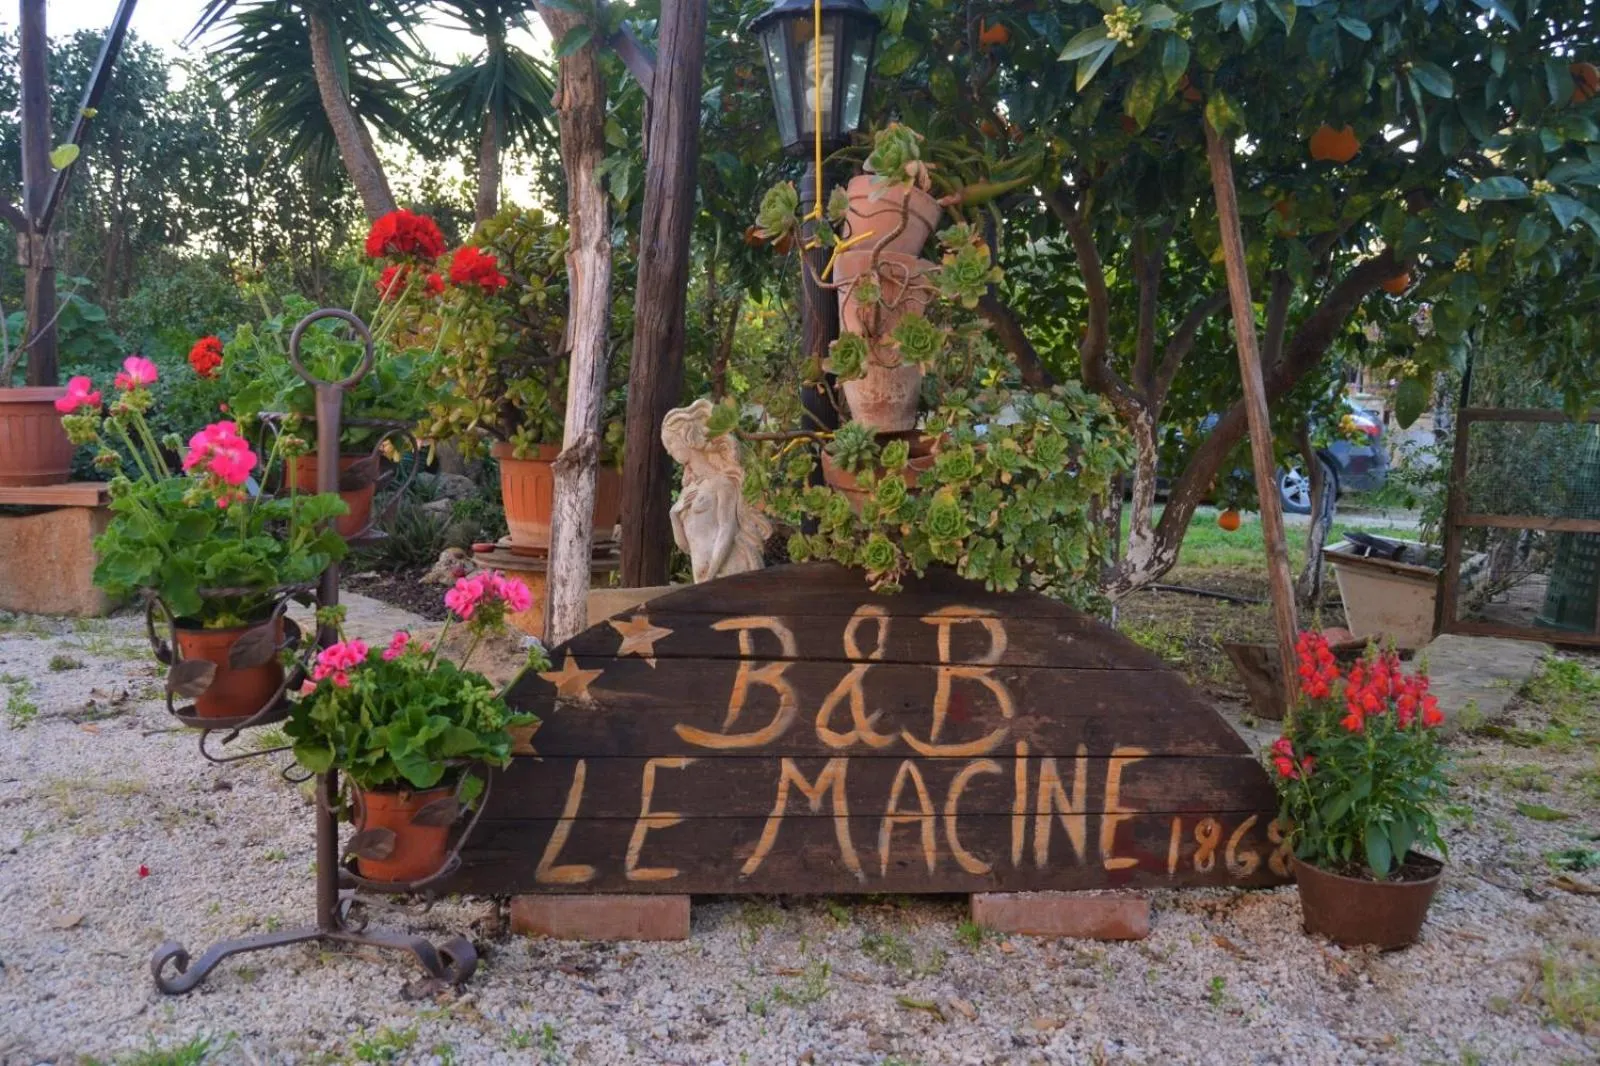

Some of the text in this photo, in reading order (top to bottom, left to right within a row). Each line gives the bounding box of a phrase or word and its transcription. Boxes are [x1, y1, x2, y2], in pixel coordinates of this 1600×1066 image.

[673, 604, 1016, 759] B&B
[535, 757, 698, 884] LE
[738, 740, 1150, 884] MACINE
